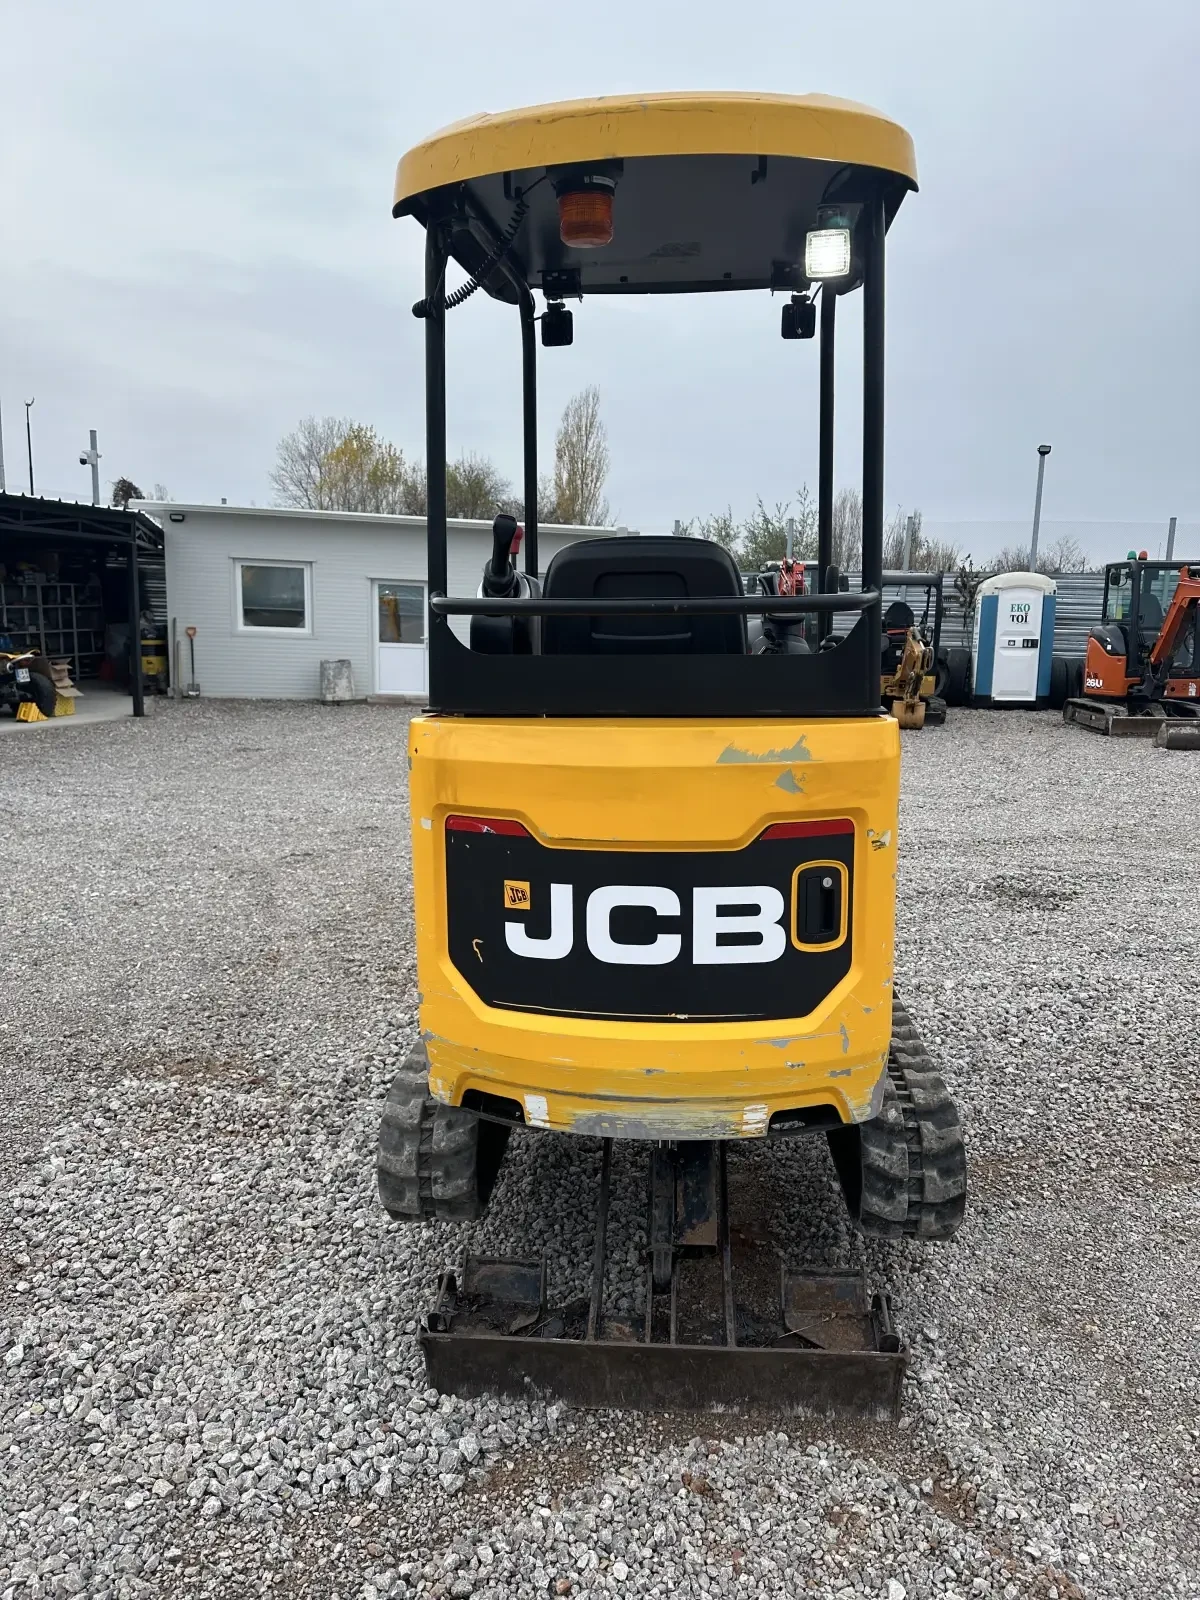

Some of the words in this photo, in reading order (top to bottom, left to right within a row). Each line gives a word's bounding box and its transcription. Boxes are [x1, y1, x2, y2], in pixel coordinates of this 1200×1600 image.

[1010, 603, 1031, 613] EKO
[509, 887, 527, 903] JCB
[505, 883, 787, 965] JCB
